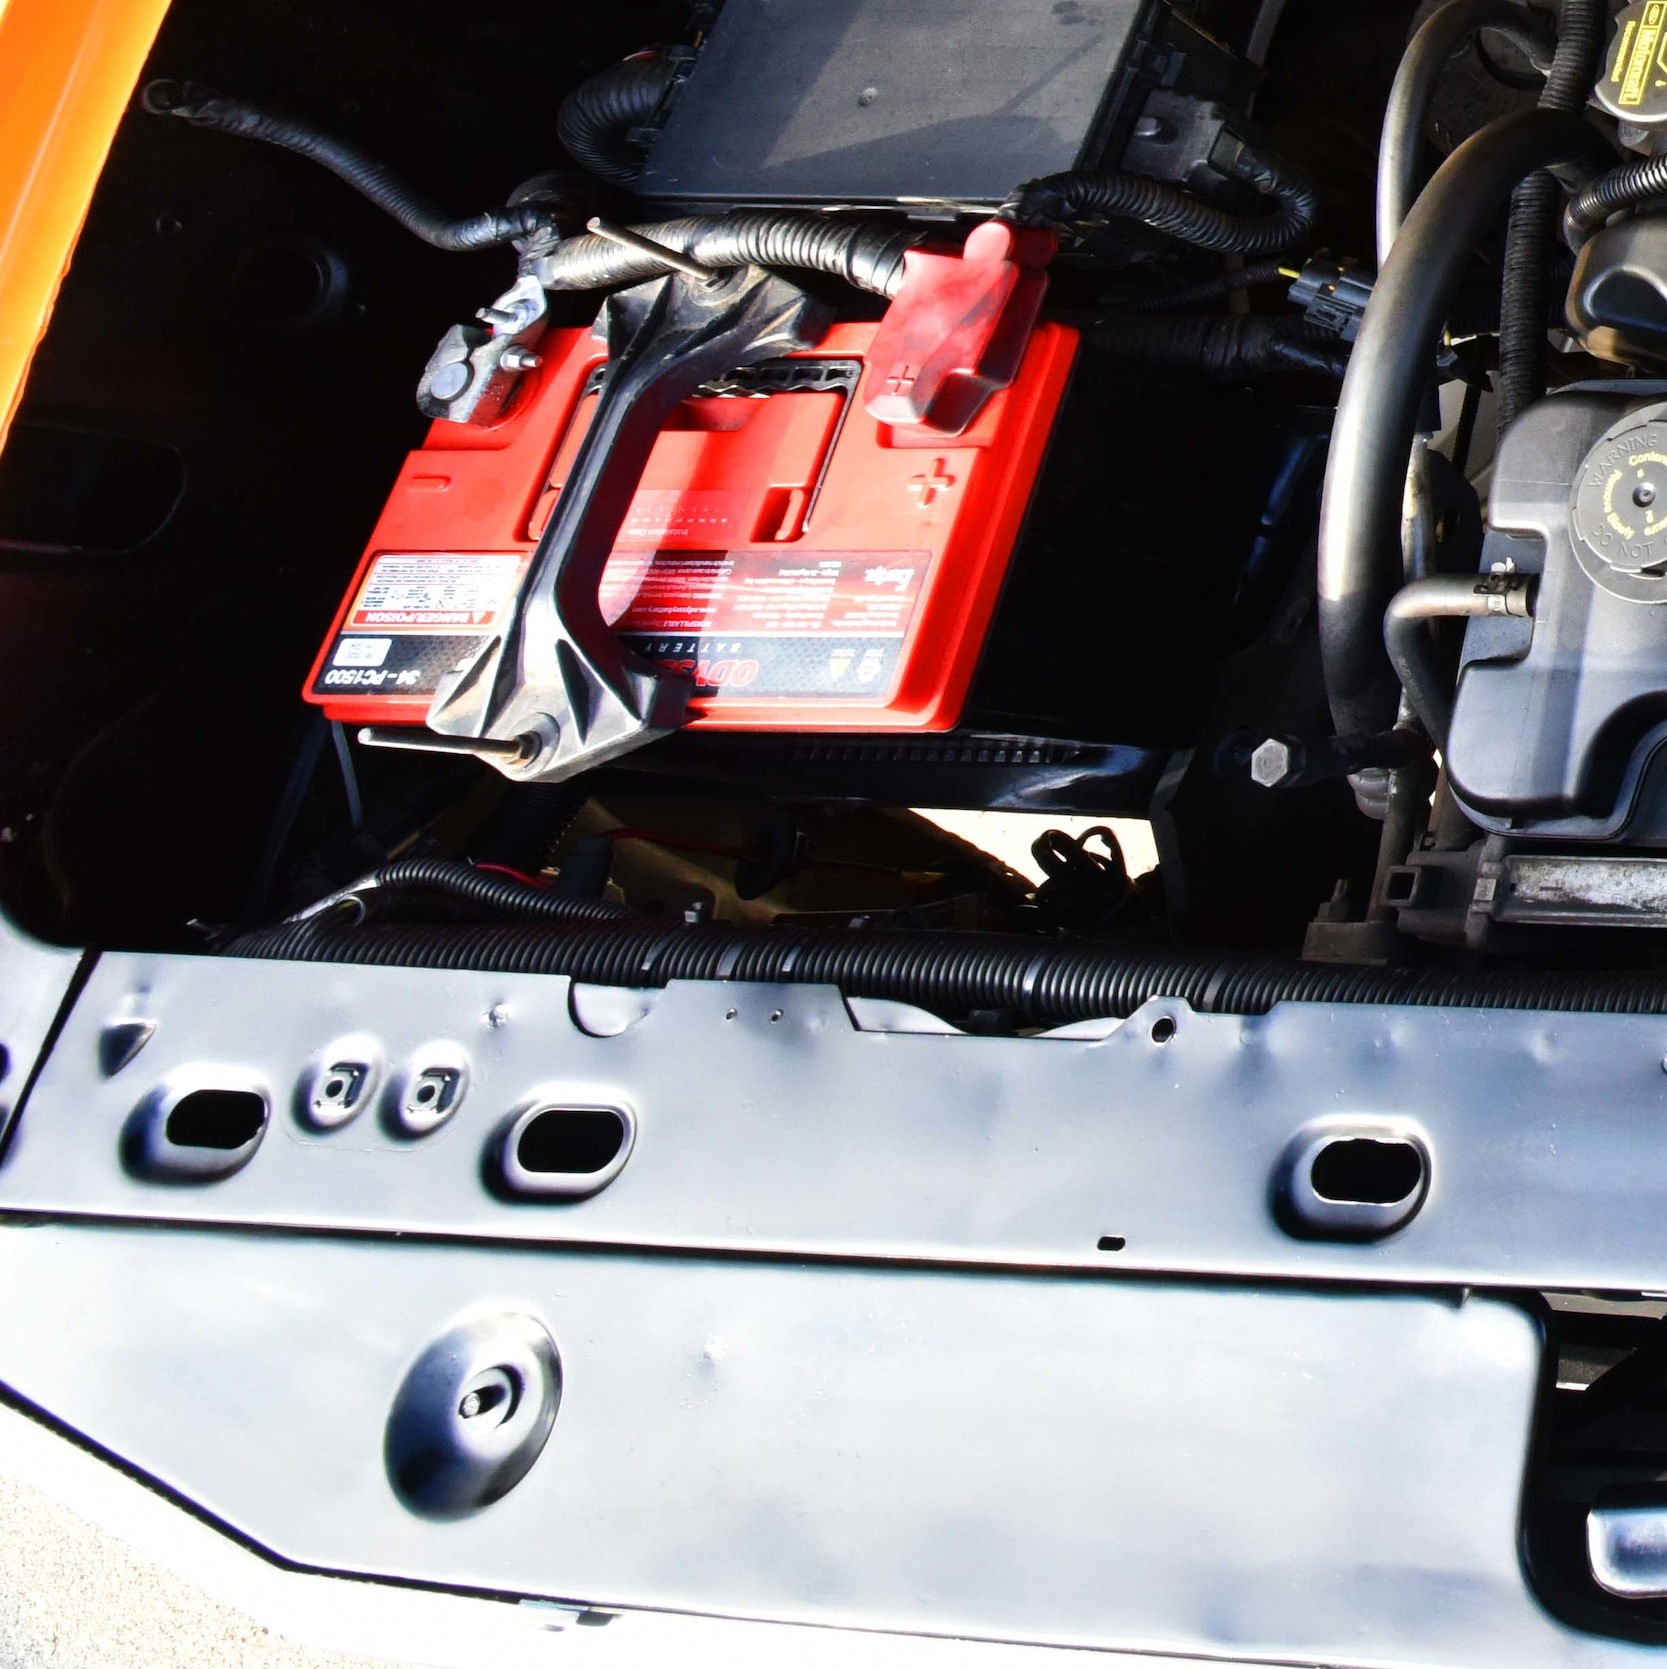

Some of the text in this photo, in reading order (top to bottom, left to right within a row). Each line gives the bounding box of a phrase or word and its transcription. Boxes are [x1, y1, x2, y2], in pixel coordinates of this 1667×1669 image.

[1610, 20, 1636, 83] Recommended
[1623, 29, 1656, 101] Motorcraft
[1588, 433, 1658, 488] WARNING
[1602, 469, 1623, 513] Remove
[1592, 522, 1613, 546] DO
[1617, 540, 1655, 558] NOT
[643, 642, 742, 653] BATTERY
